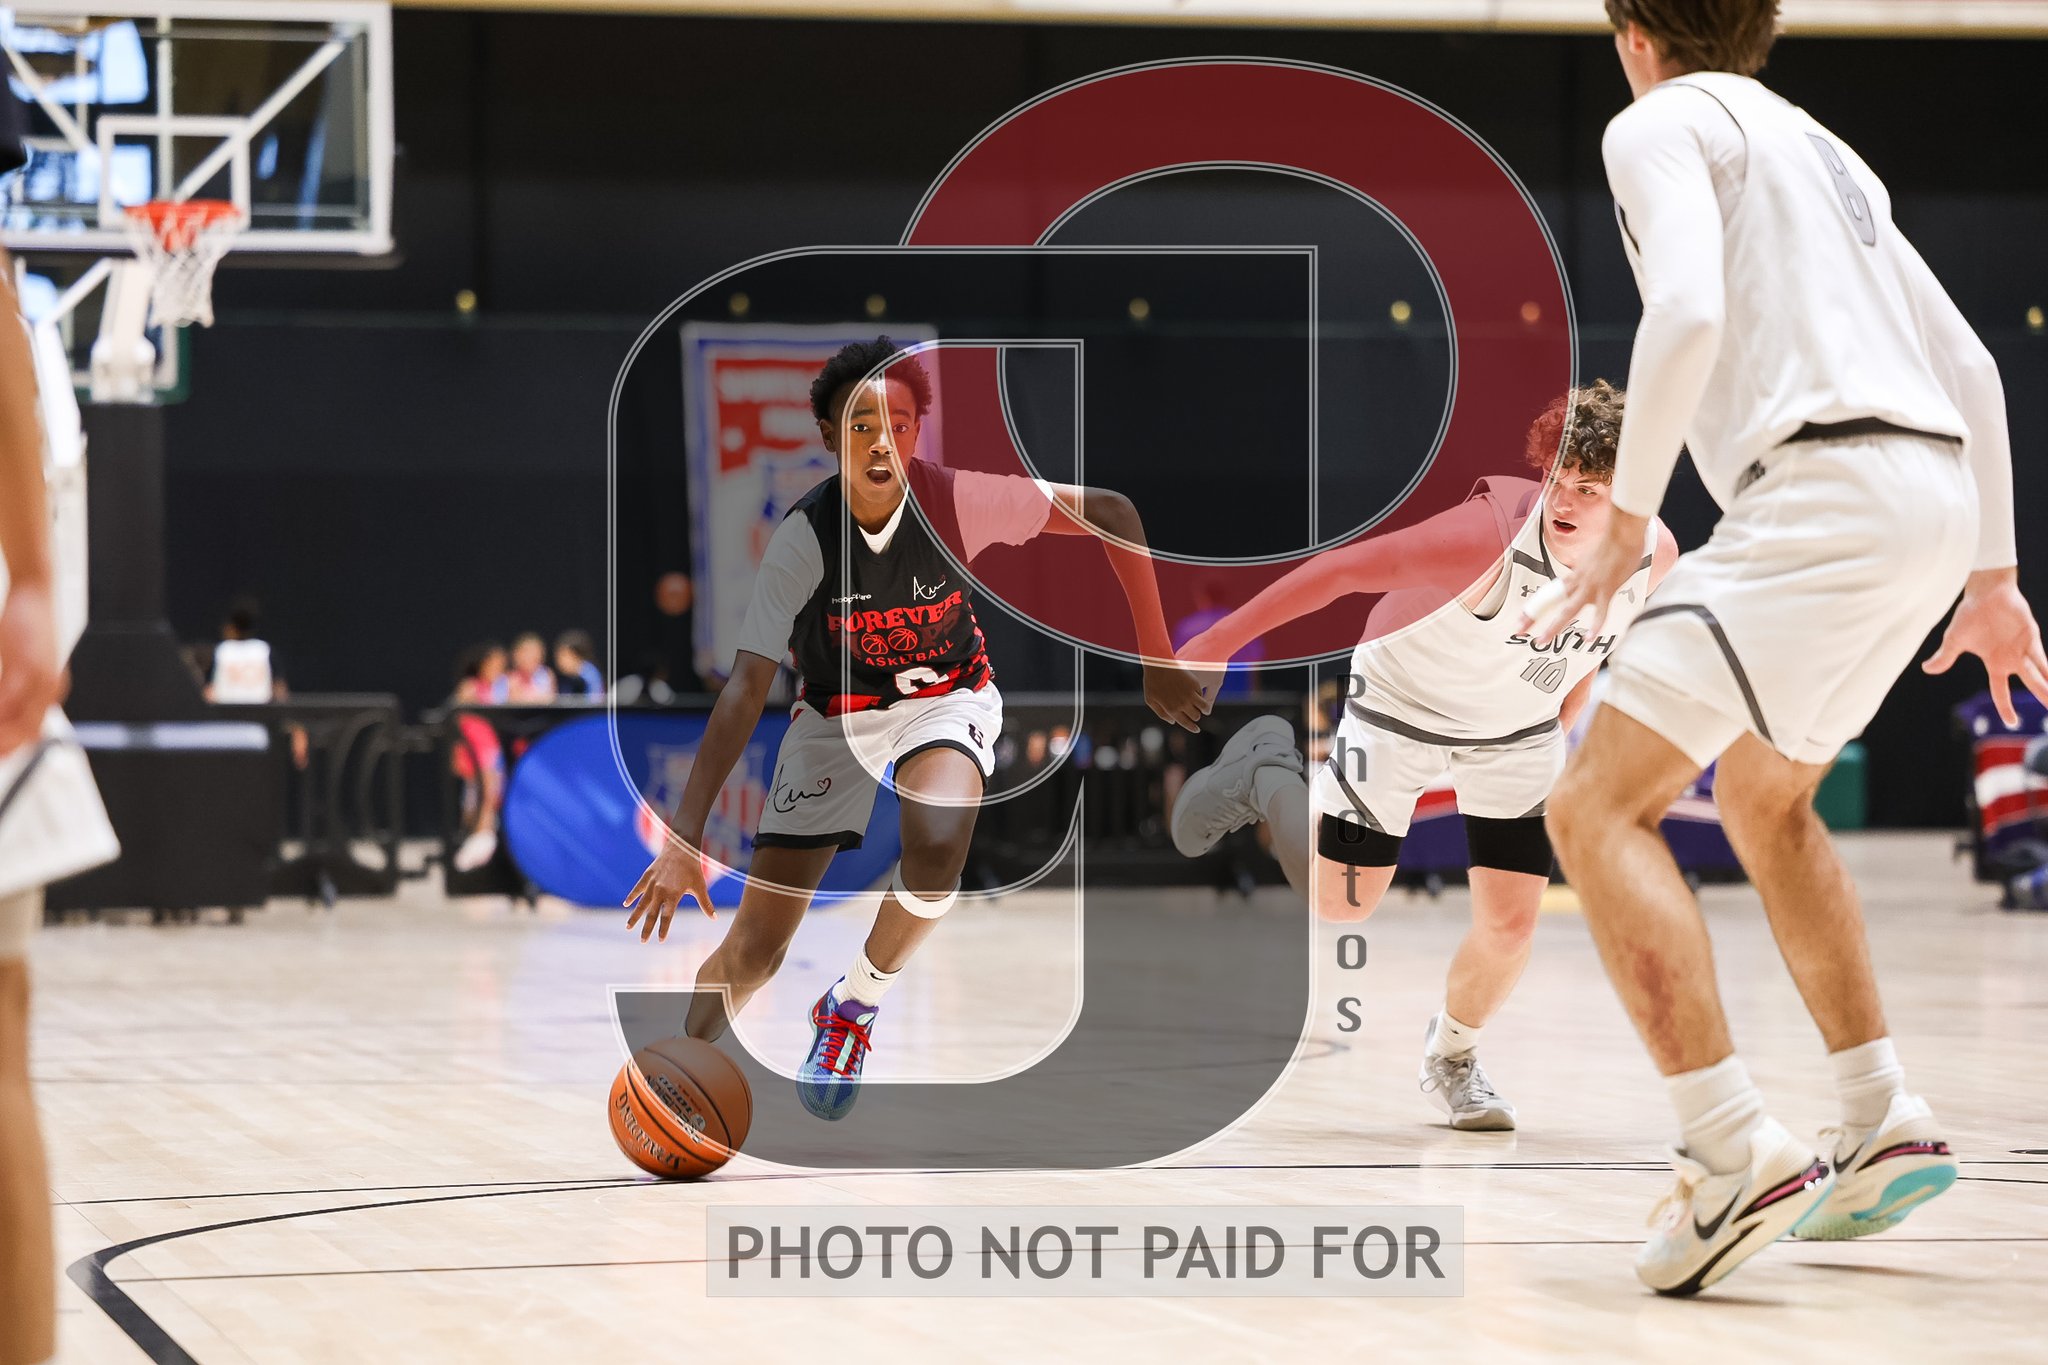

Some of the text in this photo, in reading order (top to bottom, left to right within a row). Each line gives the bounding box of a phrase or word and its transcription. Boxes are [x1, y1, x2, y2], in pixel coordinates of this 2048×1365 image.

[827, 590, 963, 633] FOREVER
[865, 639, 954, 667] ASKETBALL
[1520, 657, 1568, 694] 10
